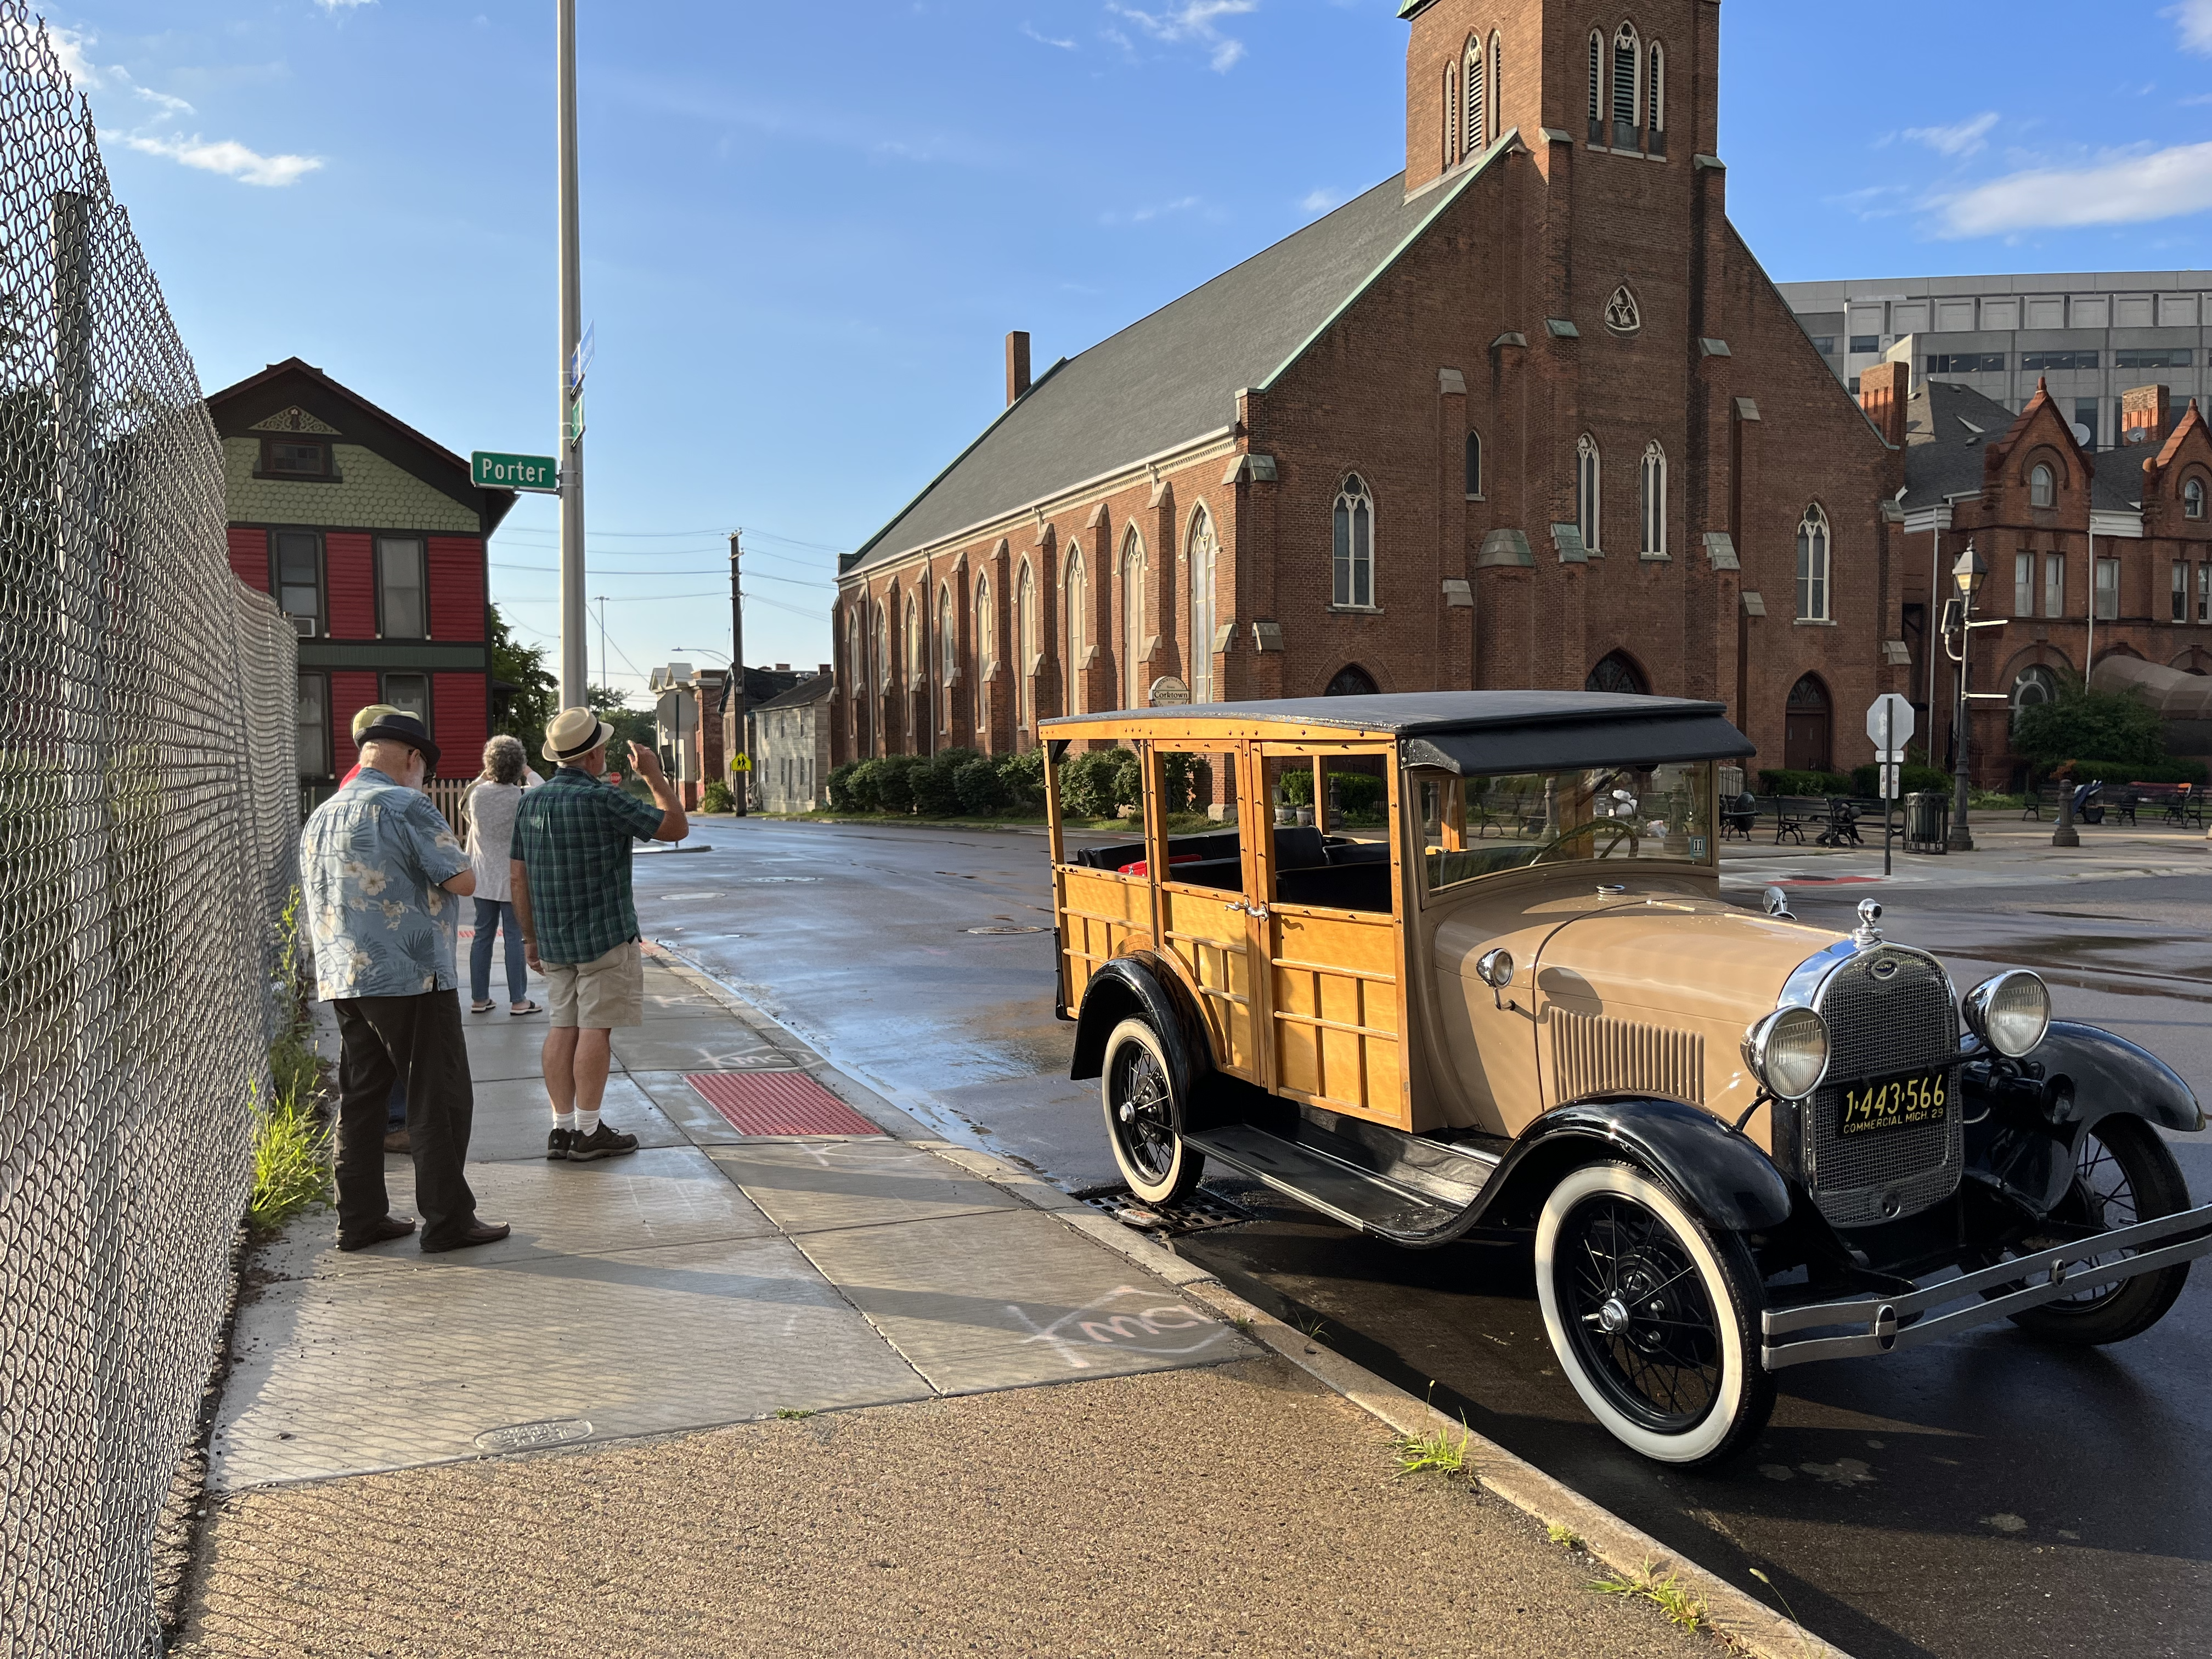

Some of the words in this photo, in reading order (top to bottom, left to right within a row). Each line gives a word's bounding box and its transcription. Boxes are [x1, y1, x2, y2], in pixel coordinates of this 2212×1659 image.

[482, 458, 546, 483] Porter
[1695, 840, 1702, 851] 11
[1843, 1115, 1903, 1134] COMMERCIAL
[1932, 1107, 1944, 1119] 29
